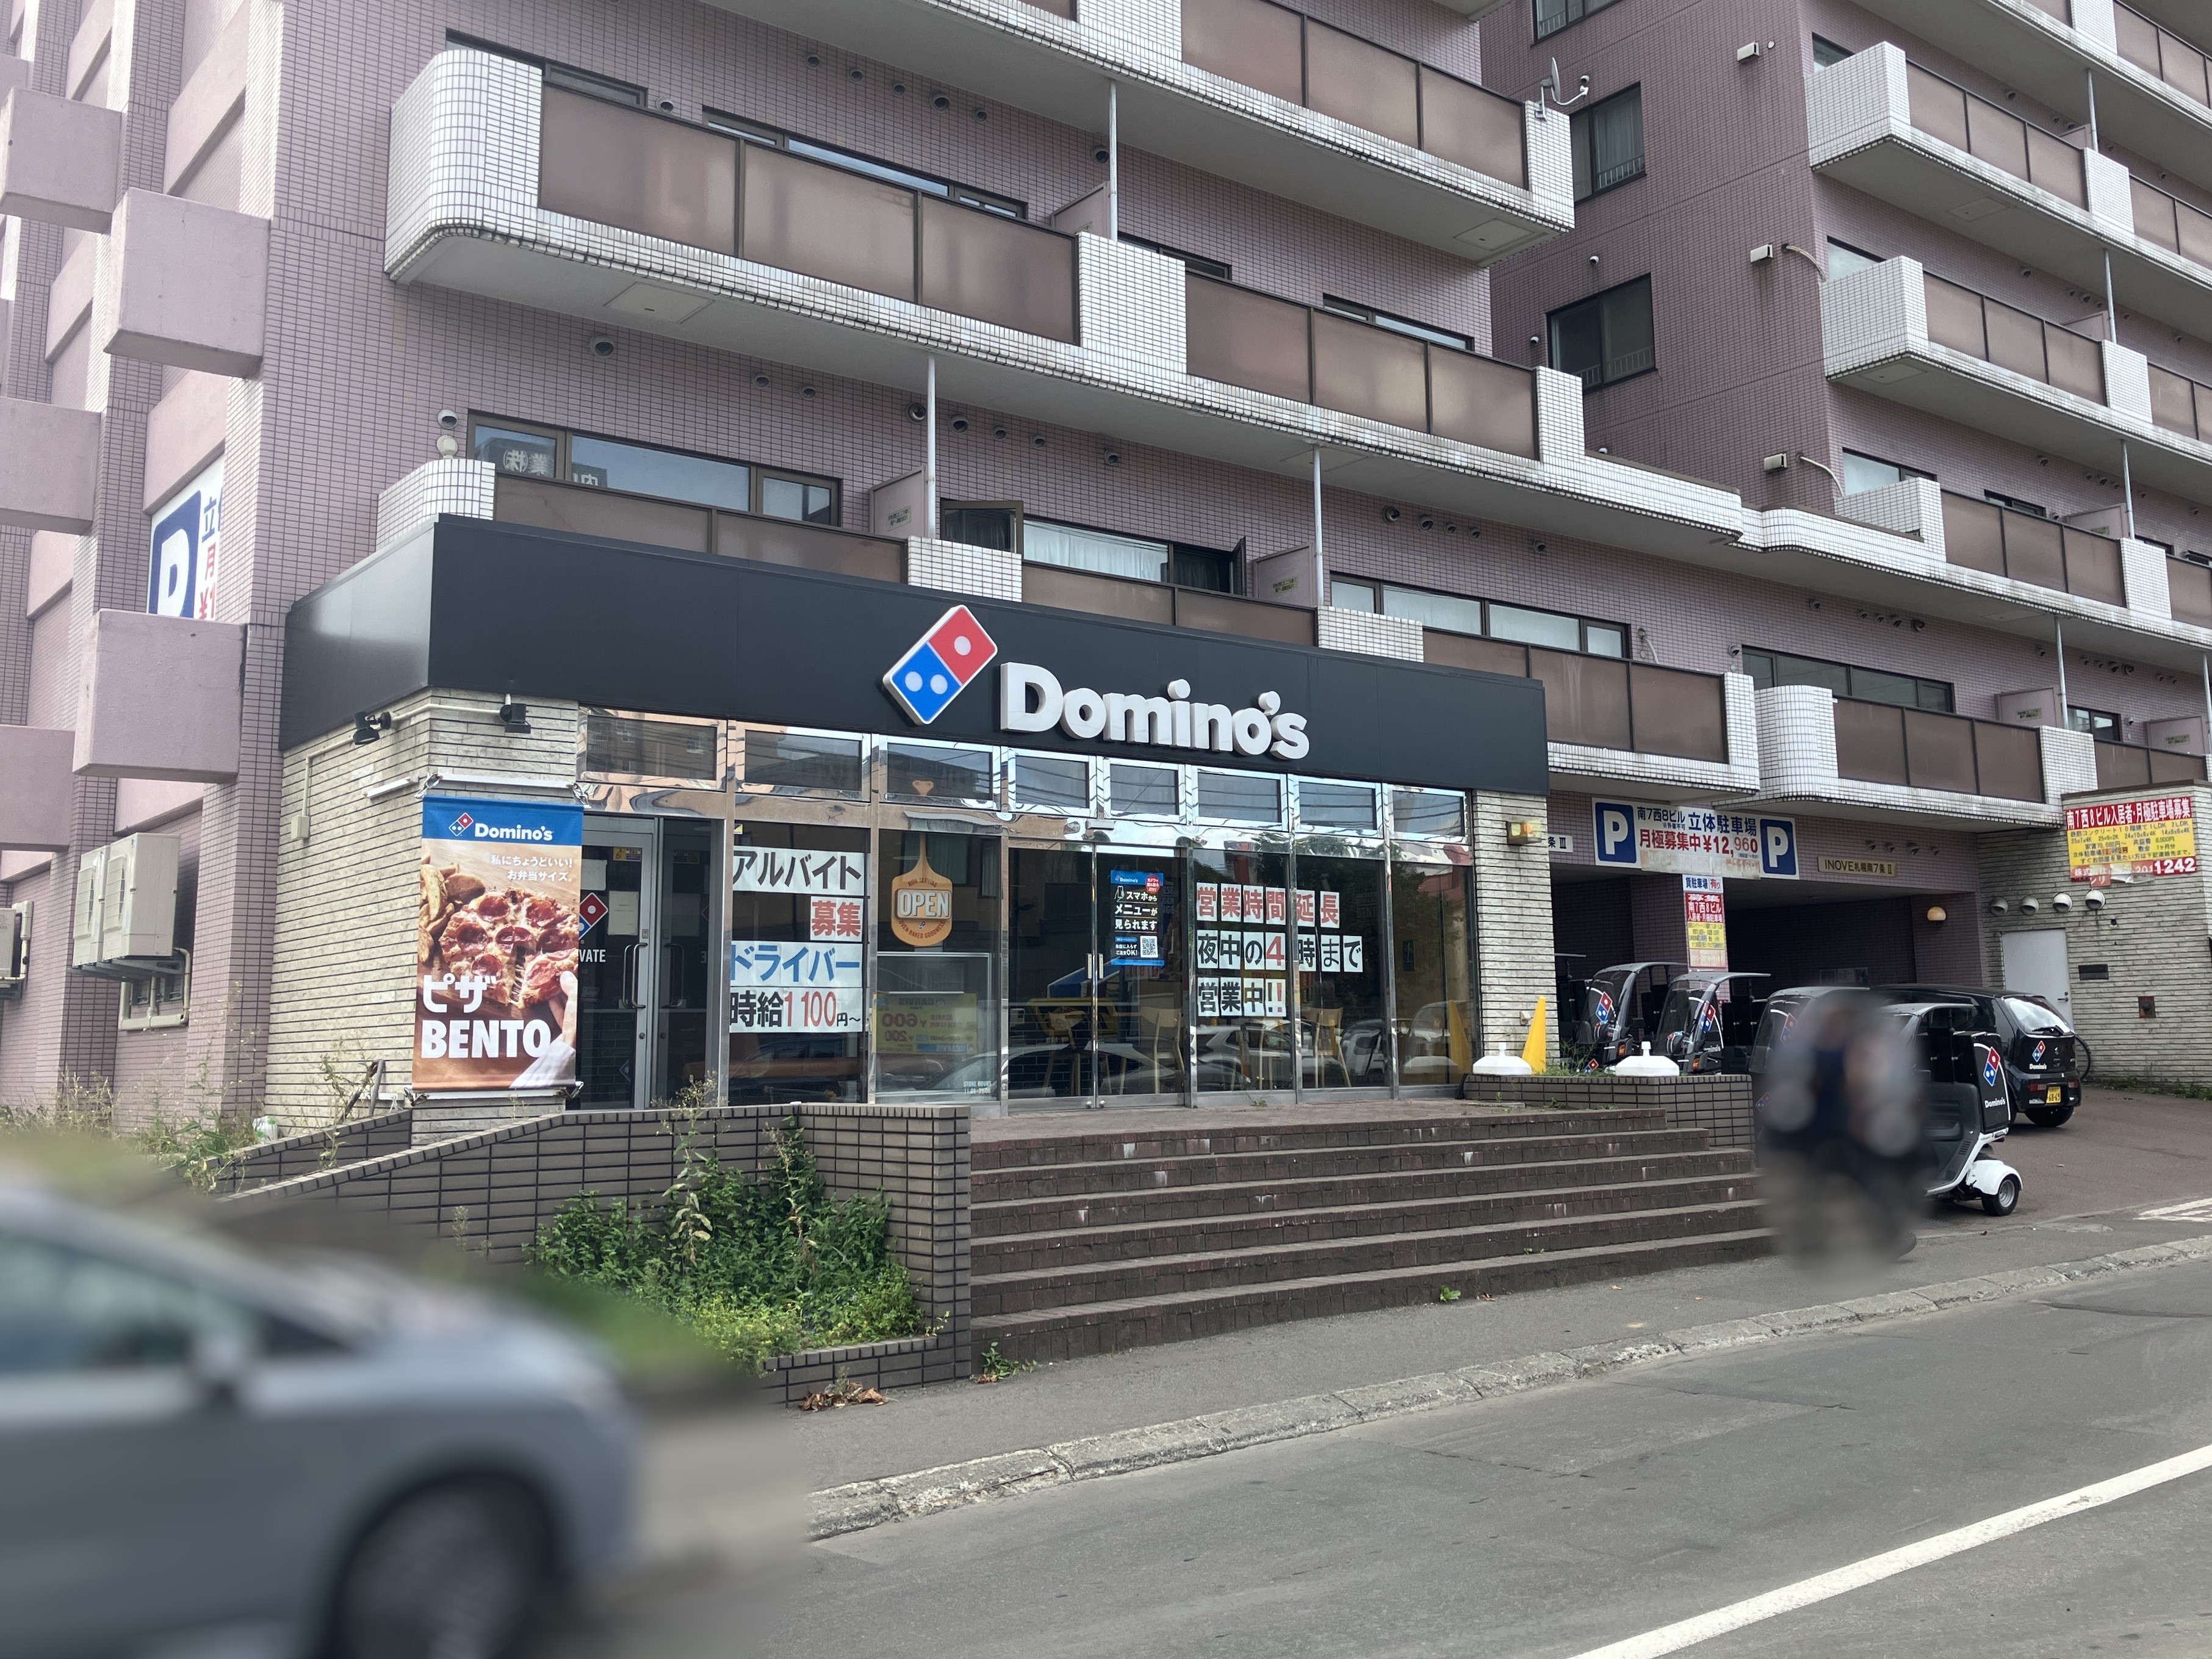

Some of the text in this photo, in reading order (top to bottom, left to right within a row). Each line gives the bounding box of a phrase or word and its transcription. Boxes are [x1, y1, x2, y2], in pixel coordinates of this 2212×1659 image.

[1000, 661, 1310, 760] Domino's
[475, 822, 553, 841] Domino's
[1603, 810, 1629, 855] P
[1637, 807, 1757, 837] 南7西8ビル 立体駐車場
[1767, 826, 1789, 868] P
[507, 869, 572, 883] お弁当サイズ。
[732, 851, 862, 890] アルバイト
[2154, 857, 2196, 874] 1242
[900, 891, 950, 917] OPEN
[1115, 904, 1158, 916] メニューが
[1126, 891, 1158, 902] スマホから
[1197, 887, 1339, 925] 営業時間延長
[812, 900, 861, 937] 募集
[1114, 919, 1158, 931] 見られます
[730, 945, 860, 982] ドライバー
[1198, 934, 1361, 968] 夜中の4時まで
[423, 973, 497, 1013] ピザ
[421, 1019, 551, 1059] BENTO
[1984, 1096, 2006, 1108] Domino's
